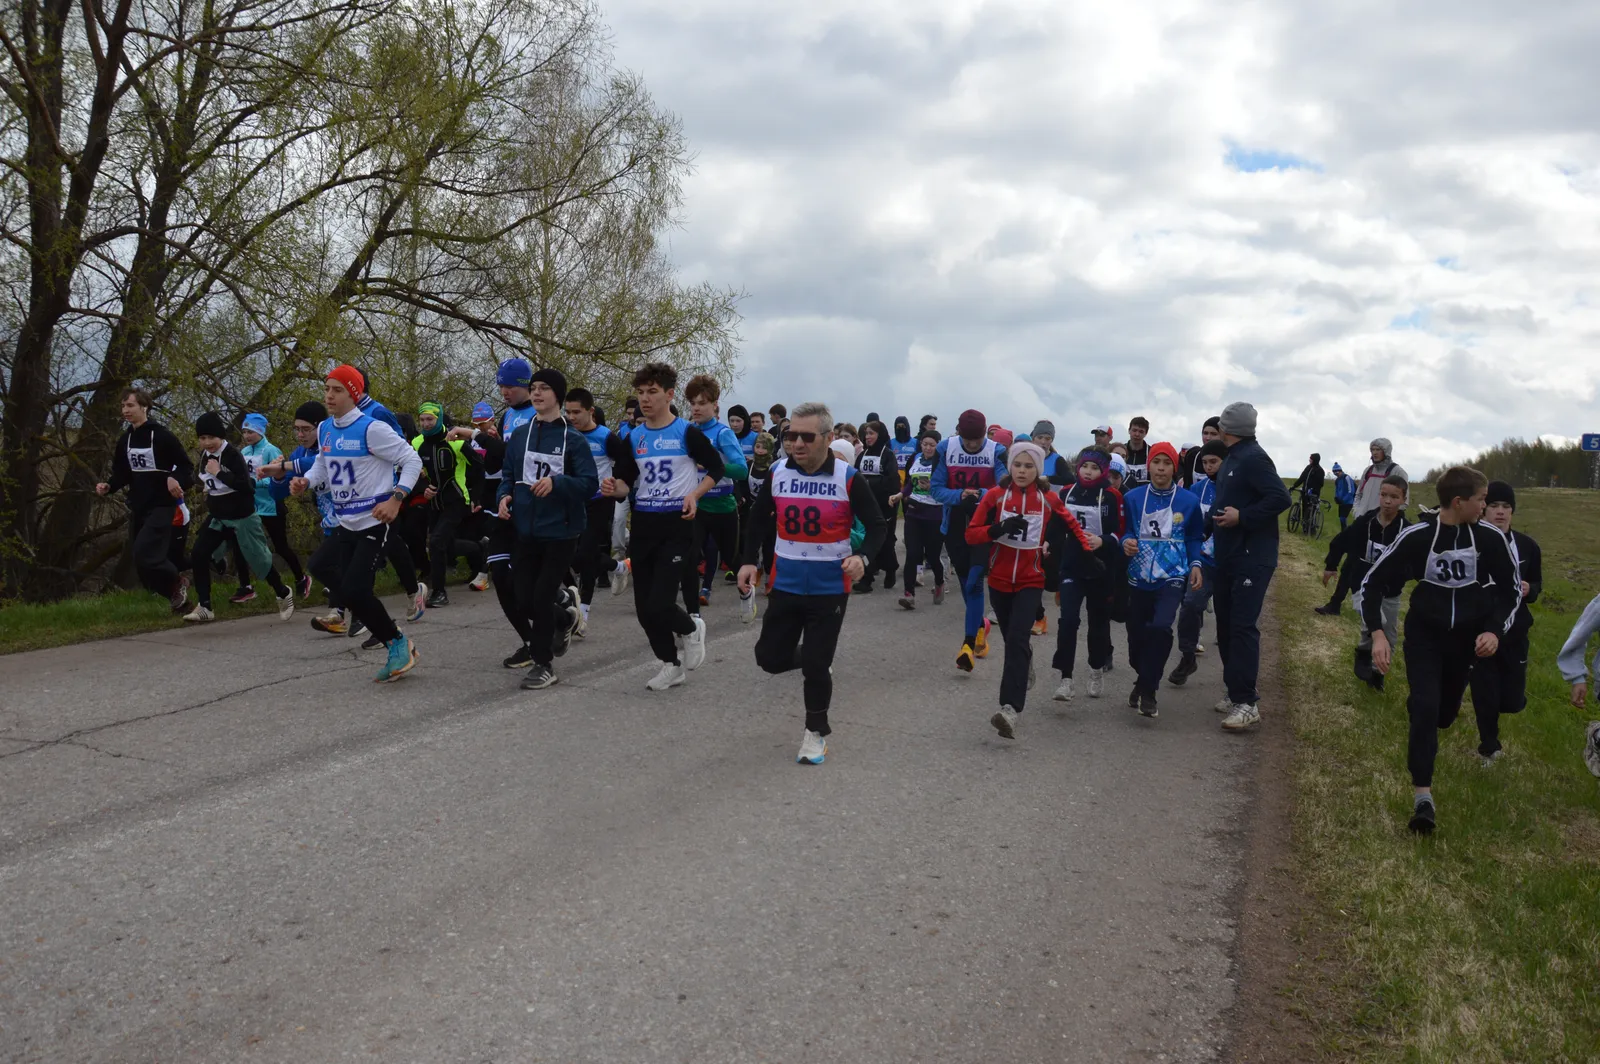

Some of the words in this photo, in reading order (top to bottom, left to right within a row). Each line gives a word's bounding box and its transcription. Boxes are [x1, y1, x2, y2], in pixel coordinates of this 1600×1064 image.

[131, 453, 147, 468] 56
[958, 453, 991, 466] Бирск
[329, 459, 356, 485] 21
[644, 459, 673, 484] 35
[954, 470, 980, 489] 94
[334, 488, 360, 499] УФА
[790, 478, 837, 497] Бирск
[784, 504, 821, 537] 88
[1148, 520, 1162, 538] 3
[1435, 558, 1466, 582] 30
